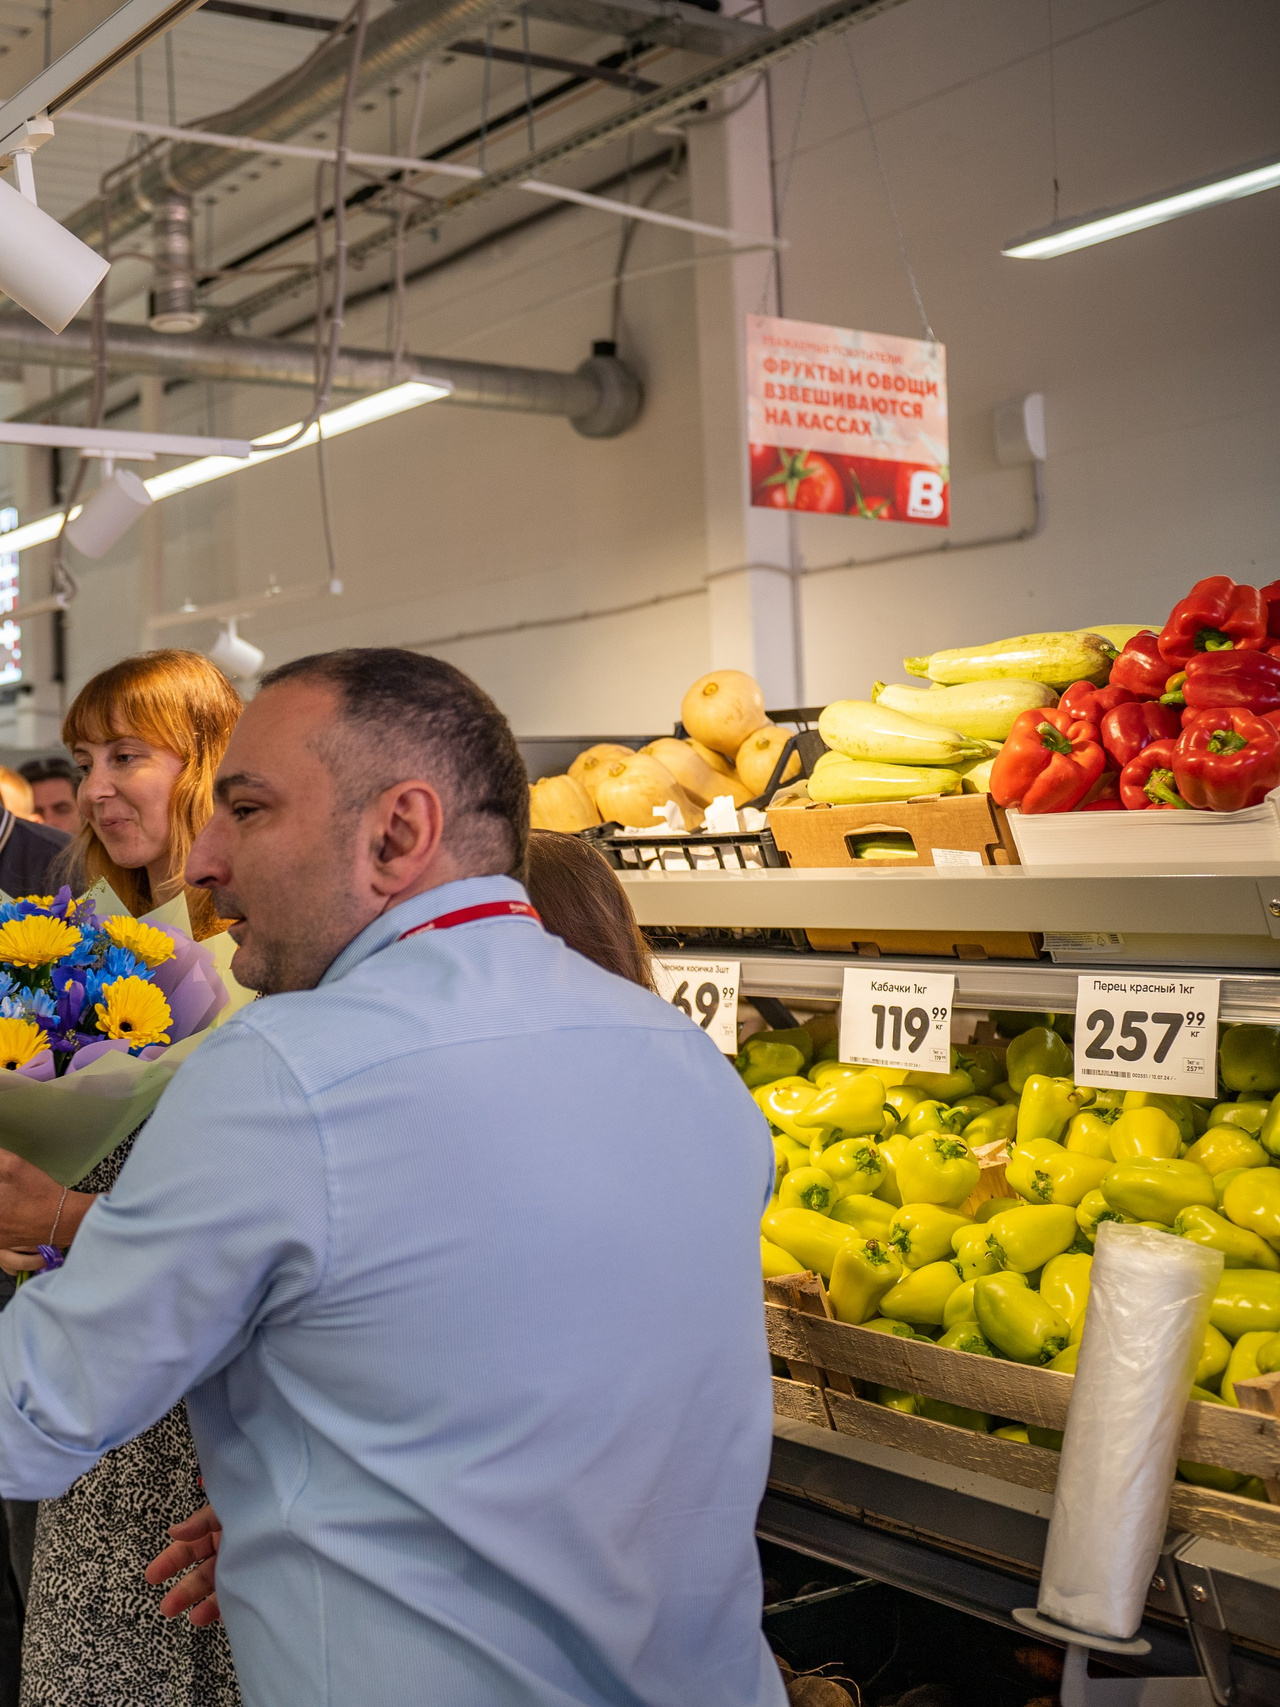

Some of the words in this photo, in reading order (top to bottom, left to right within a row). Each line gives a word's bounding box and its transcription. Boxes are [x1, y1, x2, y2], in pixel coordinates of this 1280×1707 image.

[763, 357, 844, 384] ФРУКТЫ
[849, 371, 862, 386] И
[867, 372, 939, 398] ОВОЩИ
[764, 382, 924, 419] ВЗВЕШИВАЮТСЯ
[765, 407, 792, 426] НА
[797, 412, 873, 436] КАССАХ
[722, 987, 735, 999] 99
[871, 981, 911, 994] Кабачки
[914, 984, 928, 995] 1кг
[1093, 980, 1126, 993] Перец
[1129, 983, 1176, 995] красный
[1179, 984, 1195, 994] 1кг
[872, 1004, 930, 1054] 119
[932, 1006, 948, 1020] 99
[1085, 1008, 1185, 1064] 257
[1186, 1011, 1206, 1026] 99
[1190, 1030, 1200, 1038] кг
